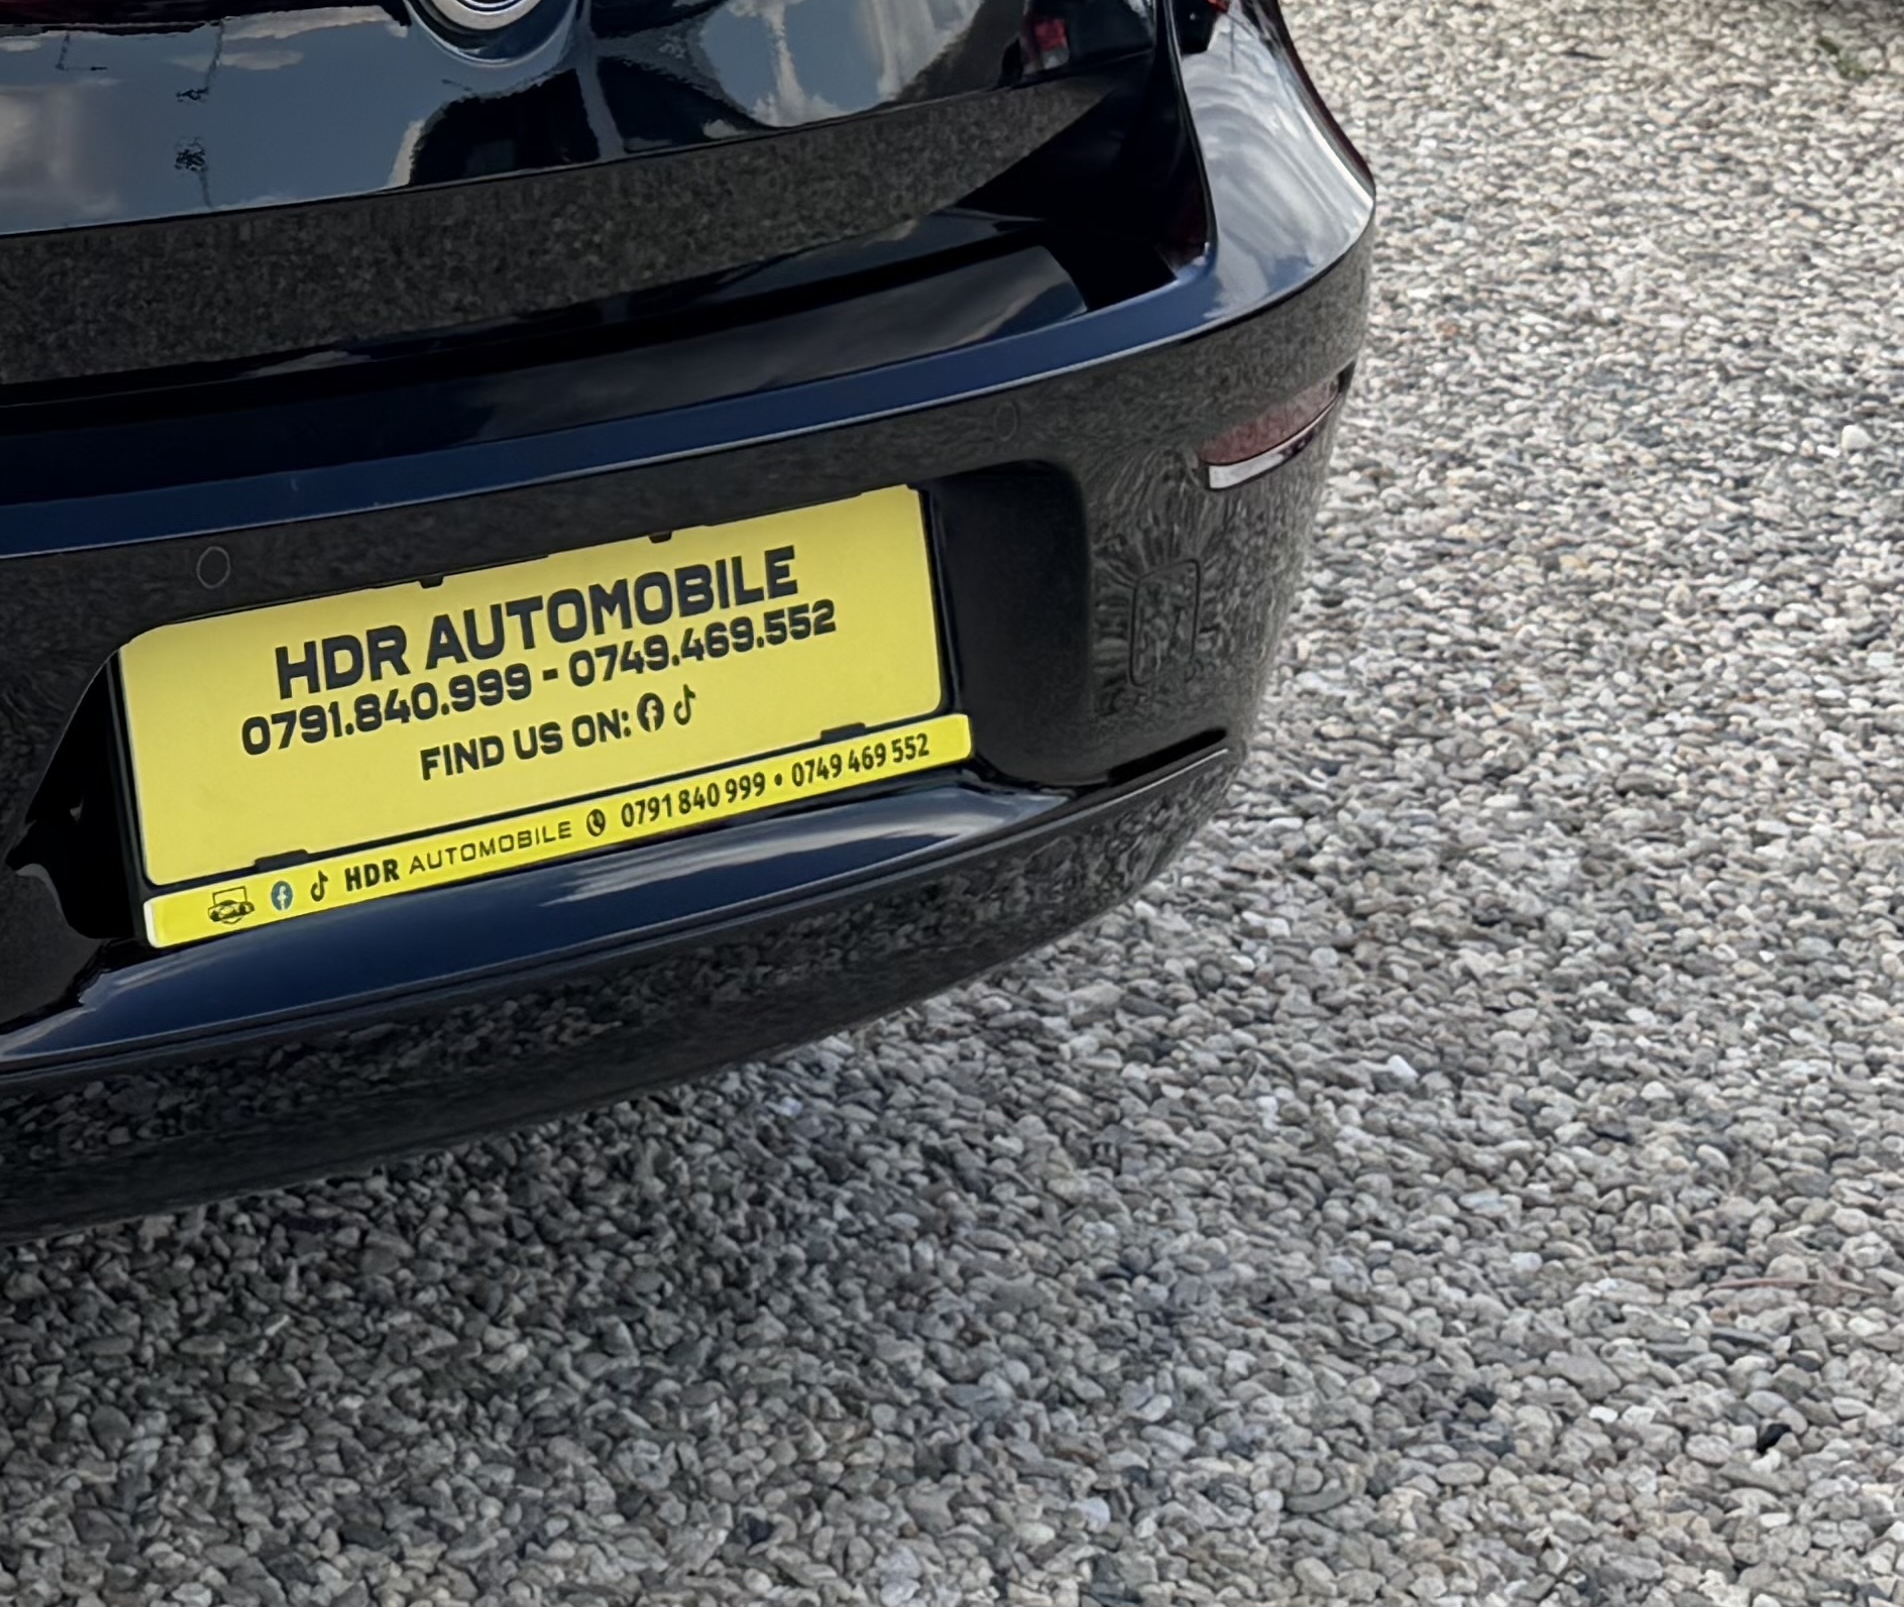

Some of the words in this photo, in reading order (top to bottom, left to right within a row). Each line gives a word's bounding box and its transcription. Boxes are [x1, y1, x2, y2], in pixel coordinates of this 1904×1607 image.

[240, 661, 533, 756] 0791.840.999
[568, 598, 837, 689] 0749.469.552
[274, 624, 407, 700] HDR
[425, 545, 799, 672] AUTOMOBILE
[344, 857, 401, 894] HDR
[408, 818, 573, 876] AUTOMOBILE
[620, 793, 675, 830] 0791
[677, 782, 719, 819] 840
[722, 771, 768, 807] 999
[790, 754, 843, 789] 0749
[845, 743, 889, 779] 469
[891, 731, 931, 767] 552
[420, 732, 505, 782] FIND
[512, 719, 563, 762] US
[571, 707, 632, 752] ON:
